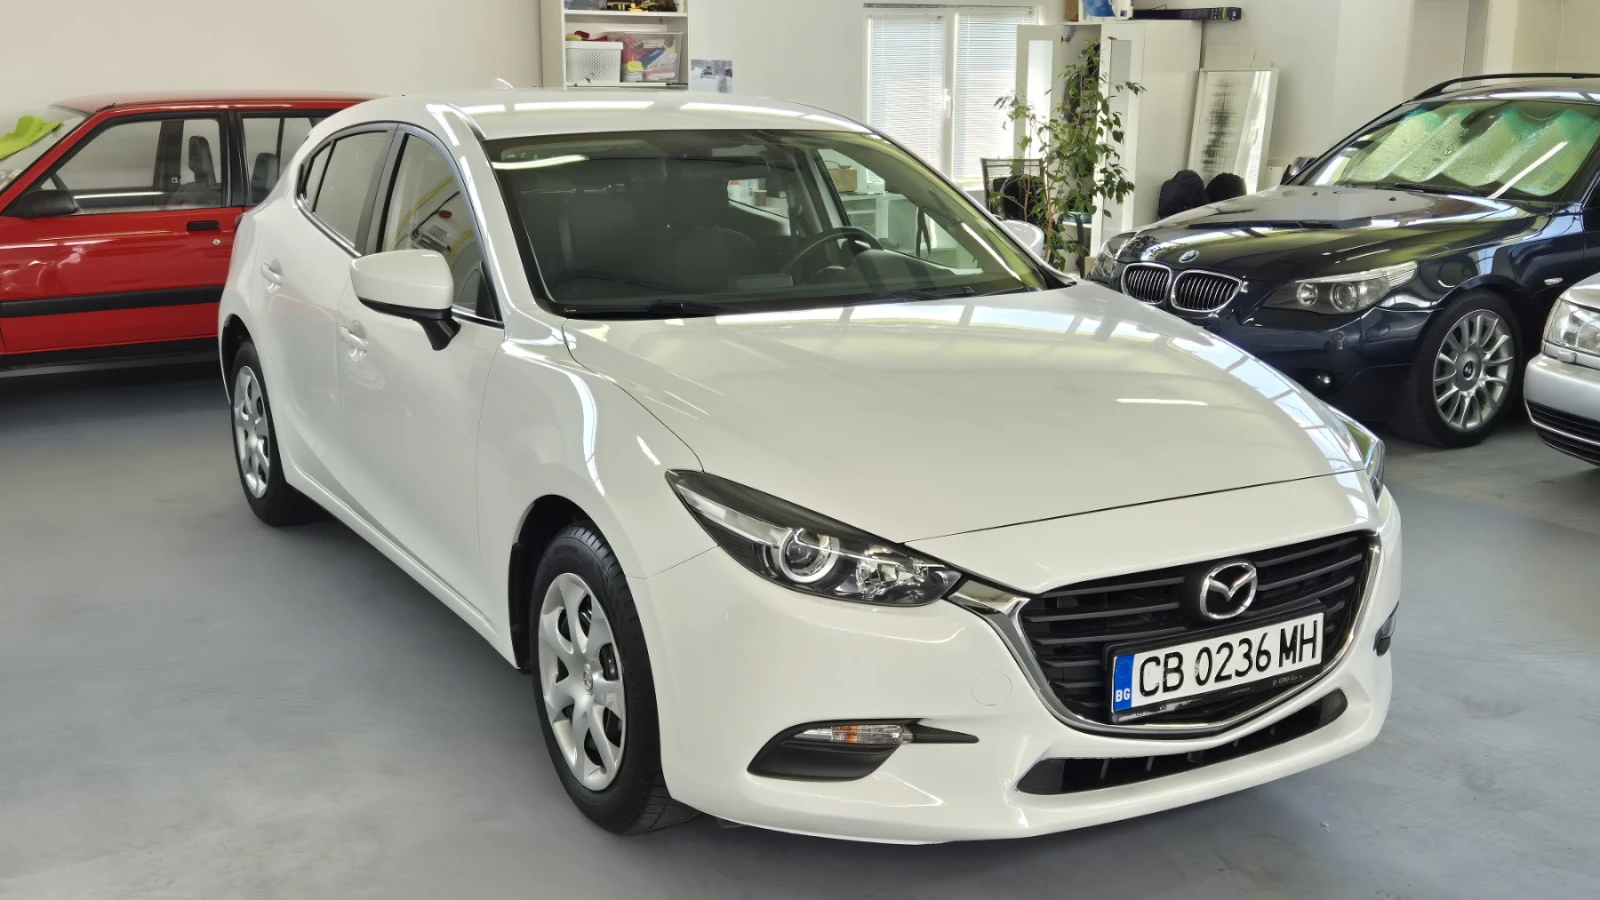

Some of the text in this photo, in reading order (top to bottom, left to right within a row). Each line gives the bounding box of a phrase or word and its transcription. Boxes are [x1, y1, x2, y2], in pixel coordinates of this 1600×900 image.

[1139, 619, 1318, 697] CB 0236 MH
[1115, 687, 1132, 703] BG
